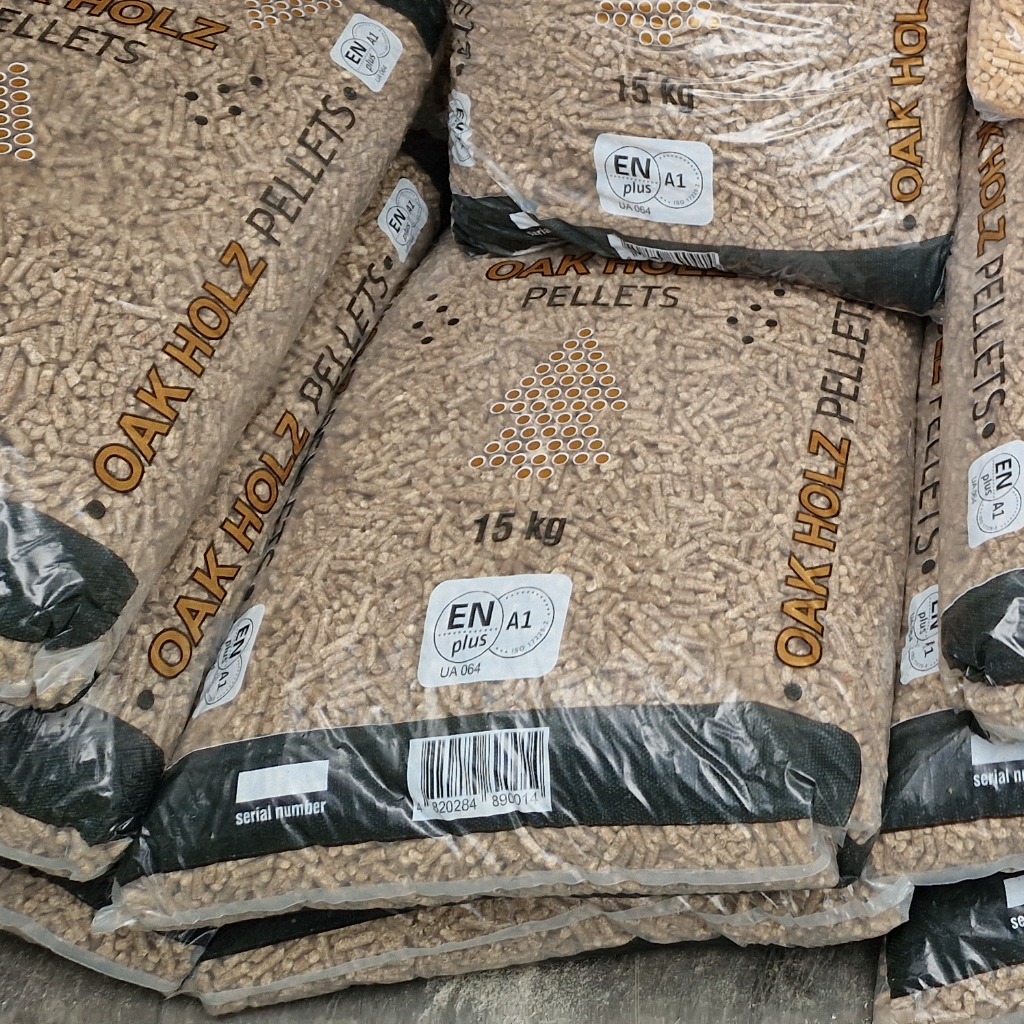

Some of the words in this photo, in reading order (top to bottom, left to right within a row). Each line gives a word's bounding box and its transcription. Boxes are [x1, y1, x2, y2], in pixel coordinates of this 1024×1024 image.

[0, 7, 147, 65] ELLETS
[367, 31, 379, 45] A1
[345, 41, 367, 65] EN
[366, 53, 376, 73] plus
[616, 77, 649, 106] 15
[661, 77, 696, 114] kg
[890, 96, 923, 205] OAK
[614, 154, 651, 179] EN
[623, 181, 652, 197] plus
[664, 172, 686, 188] A1
[619, 202, 633, 212] UA
[634, 204, 651, 216] 064
[977, 145, 1007, 258] HOLZ
[388, 208, 406, 234] EN
[486, 253, 595, 281] OAK
[93, 362, 195, 493] OAK
[162, 239, 268, 378] HOLZ
[246, 95, 357, 246] PELLETS
[521, 284, 682, 309] PELLETS
[972, 253, 1006, 422] PELLETS
[816, 301, 871, 424] PELLET
[148, 540, 241, 679] OAK
[223, 409, 310, 553] HOLZ
[299, 262, 389, 416] PELLETS
[995, 458, 1013, 492] EN
[793, 429, 852, 553] HOLZ
[981, 473, 992, 497] plus
[993, 501, 1005, 520] A1
[474, 512, 513, 544] 15
[524, 512, 568, 546] kg
[447, 600, 495, 630] EN
[506, 610, 532, 631] A1
[774, 556, 833, 668] OAK
[918, 612, 926, 635] plus
[229, 624, 250, 659] EN
[451, 633, 487, 657] plus
[511, 646, 525, 655] ISO
[217, 671, 229, 691] A1
[440, 666, 457, 678] UA
[460, 663, 481, 677] 064
[973, 768, 1009, 788] serial
[235, 805, 271, 826] serial
[275, 800, 326, 820] number
[416, 802, 422, 813] 4
[432, 798, 477, 814] 820284
[492, 792, 539, 808] 890014
